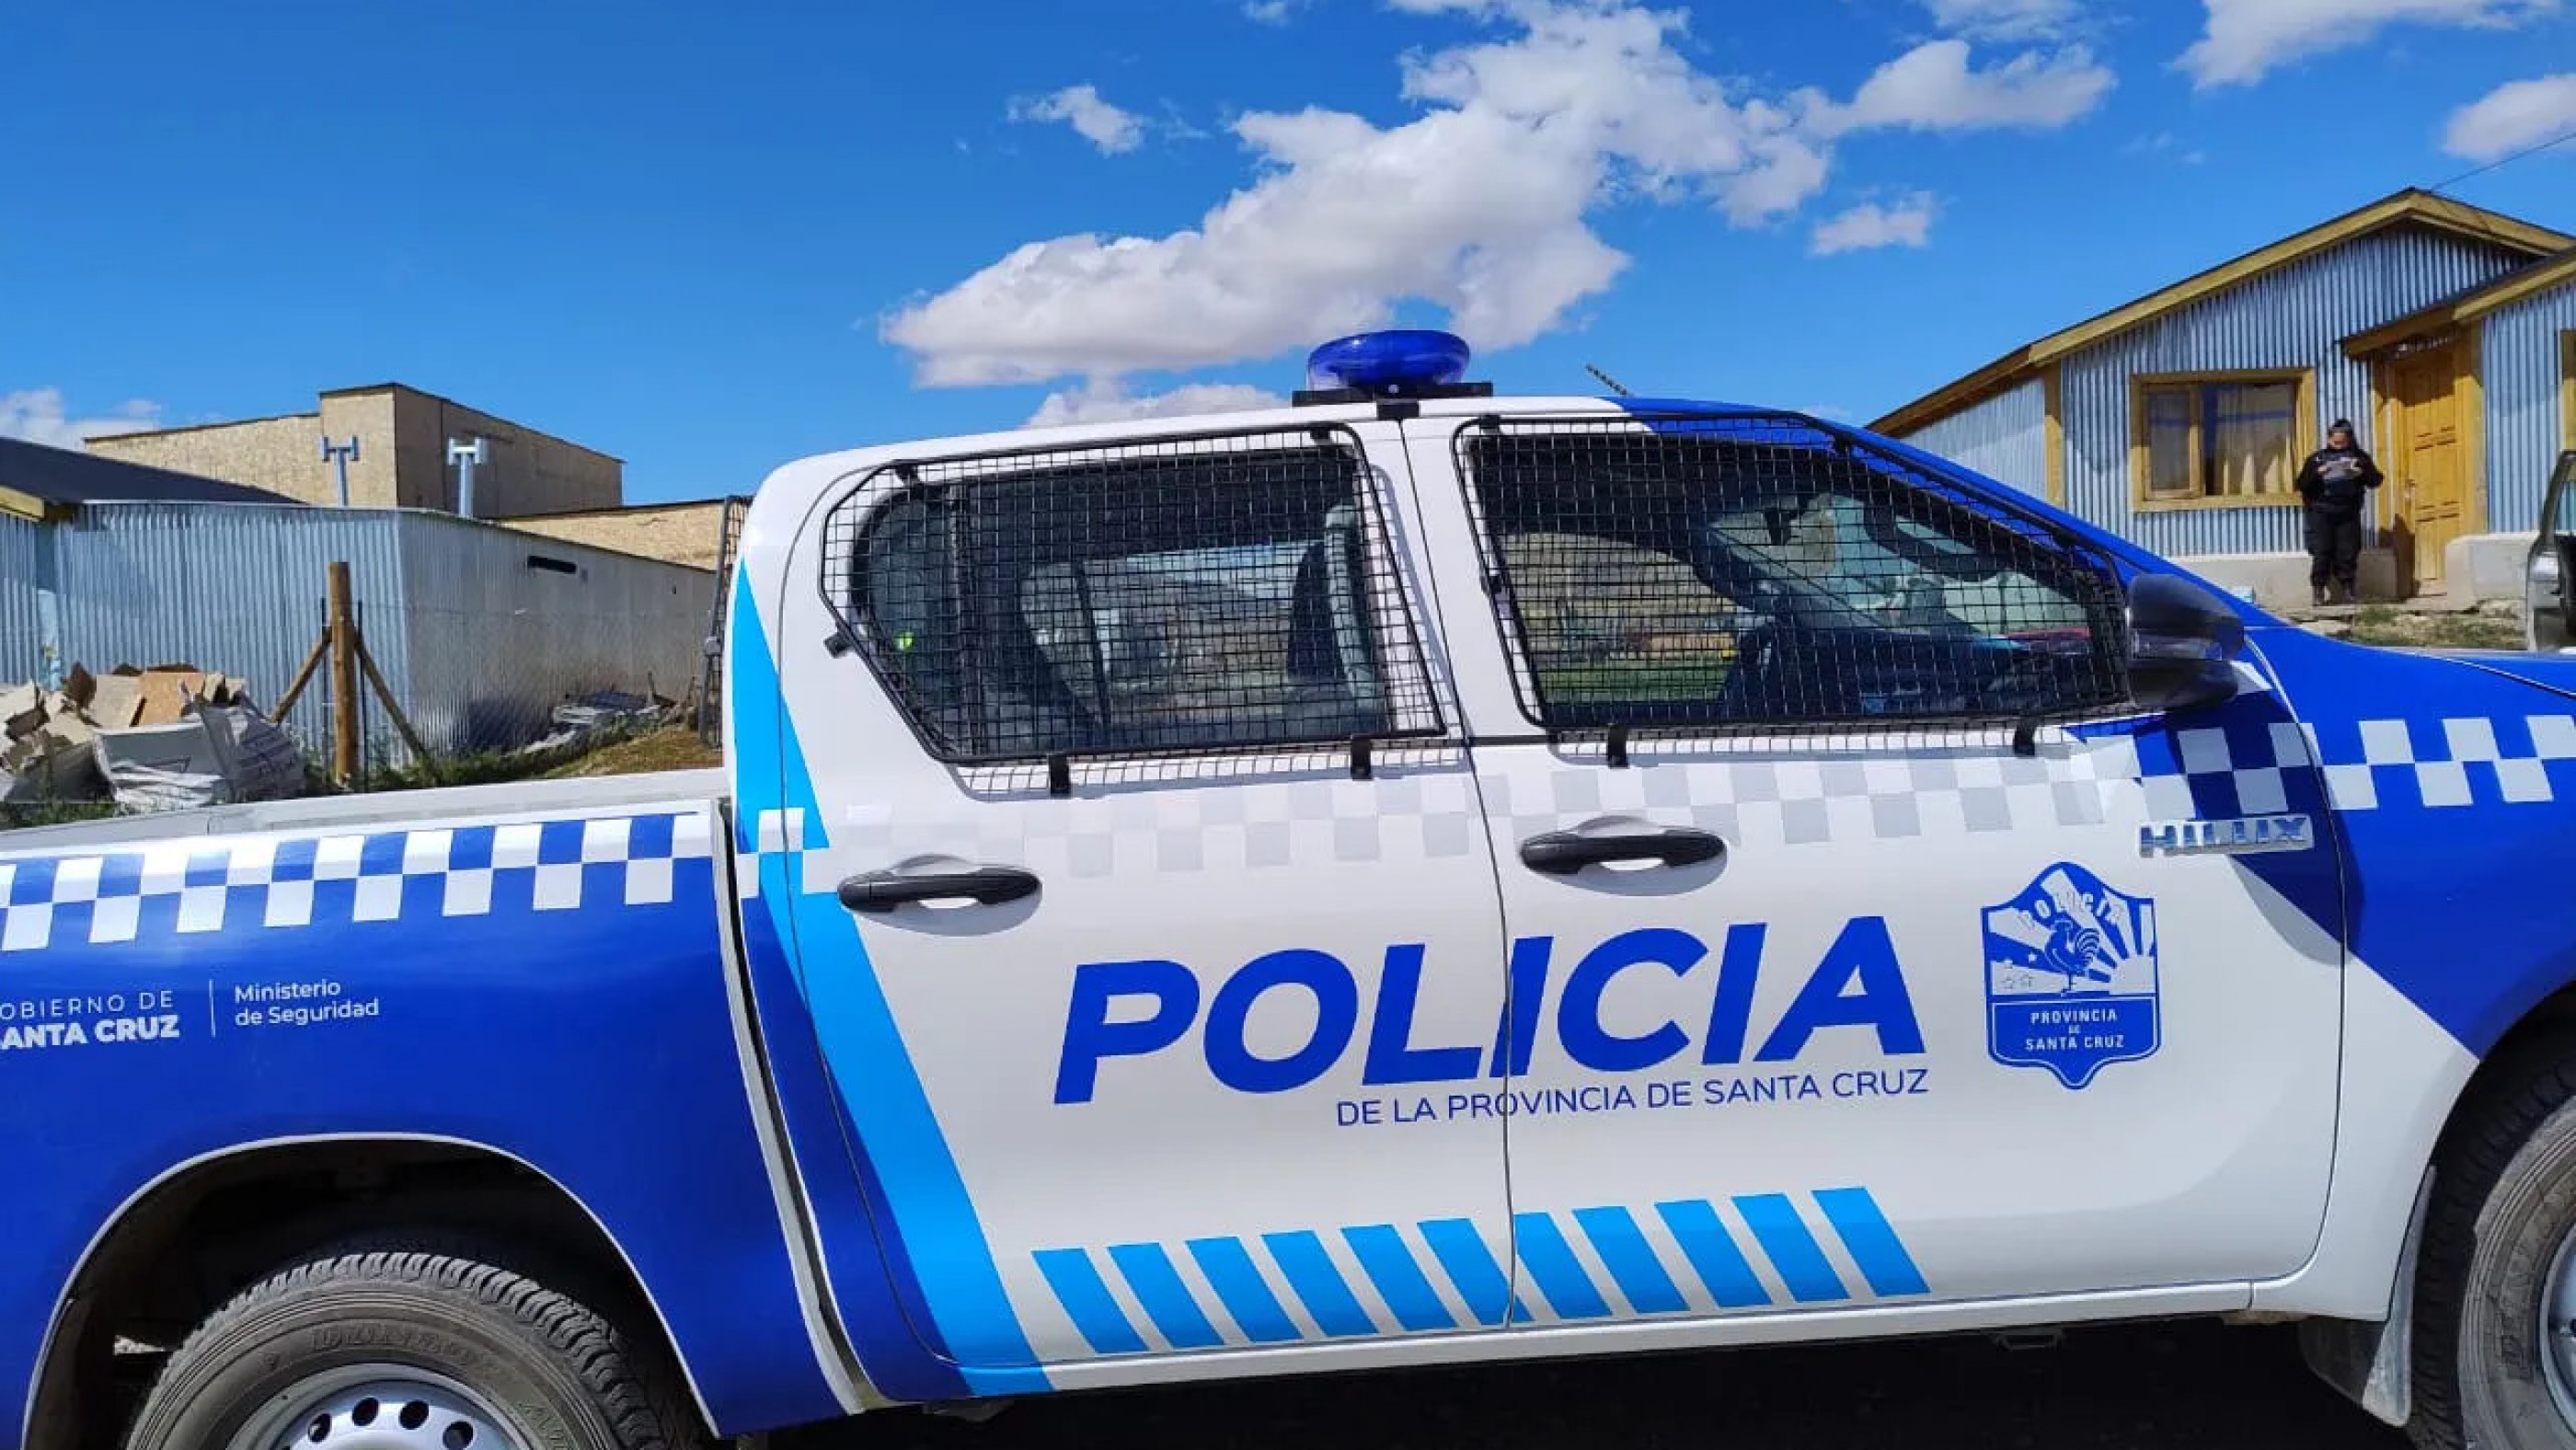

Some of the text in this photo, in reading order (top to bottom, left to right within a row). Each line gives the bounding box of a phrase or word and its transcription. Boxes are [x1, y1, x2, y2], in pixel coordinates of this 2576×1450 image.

[2137, 814, 2314, 857] HILUX
[0, 990, 173, 1021] OBIERNO DE
[235, 979, 340, 1003] Ministerio
[235, 998, 380, 1027] de Seguridad
[1054, 915, 1927, 1105] POLICIA
[2030, 1008, 2118, 1025] PROVINCIA
[0, 1014, 180, 1051] ANTA CRUZ
[2025, 1034, 2124, 1051] SANTA CRUZ
[1337, 1068, 1930, 1126] DE LA PROVINCIA DE SANTA CRUZ
